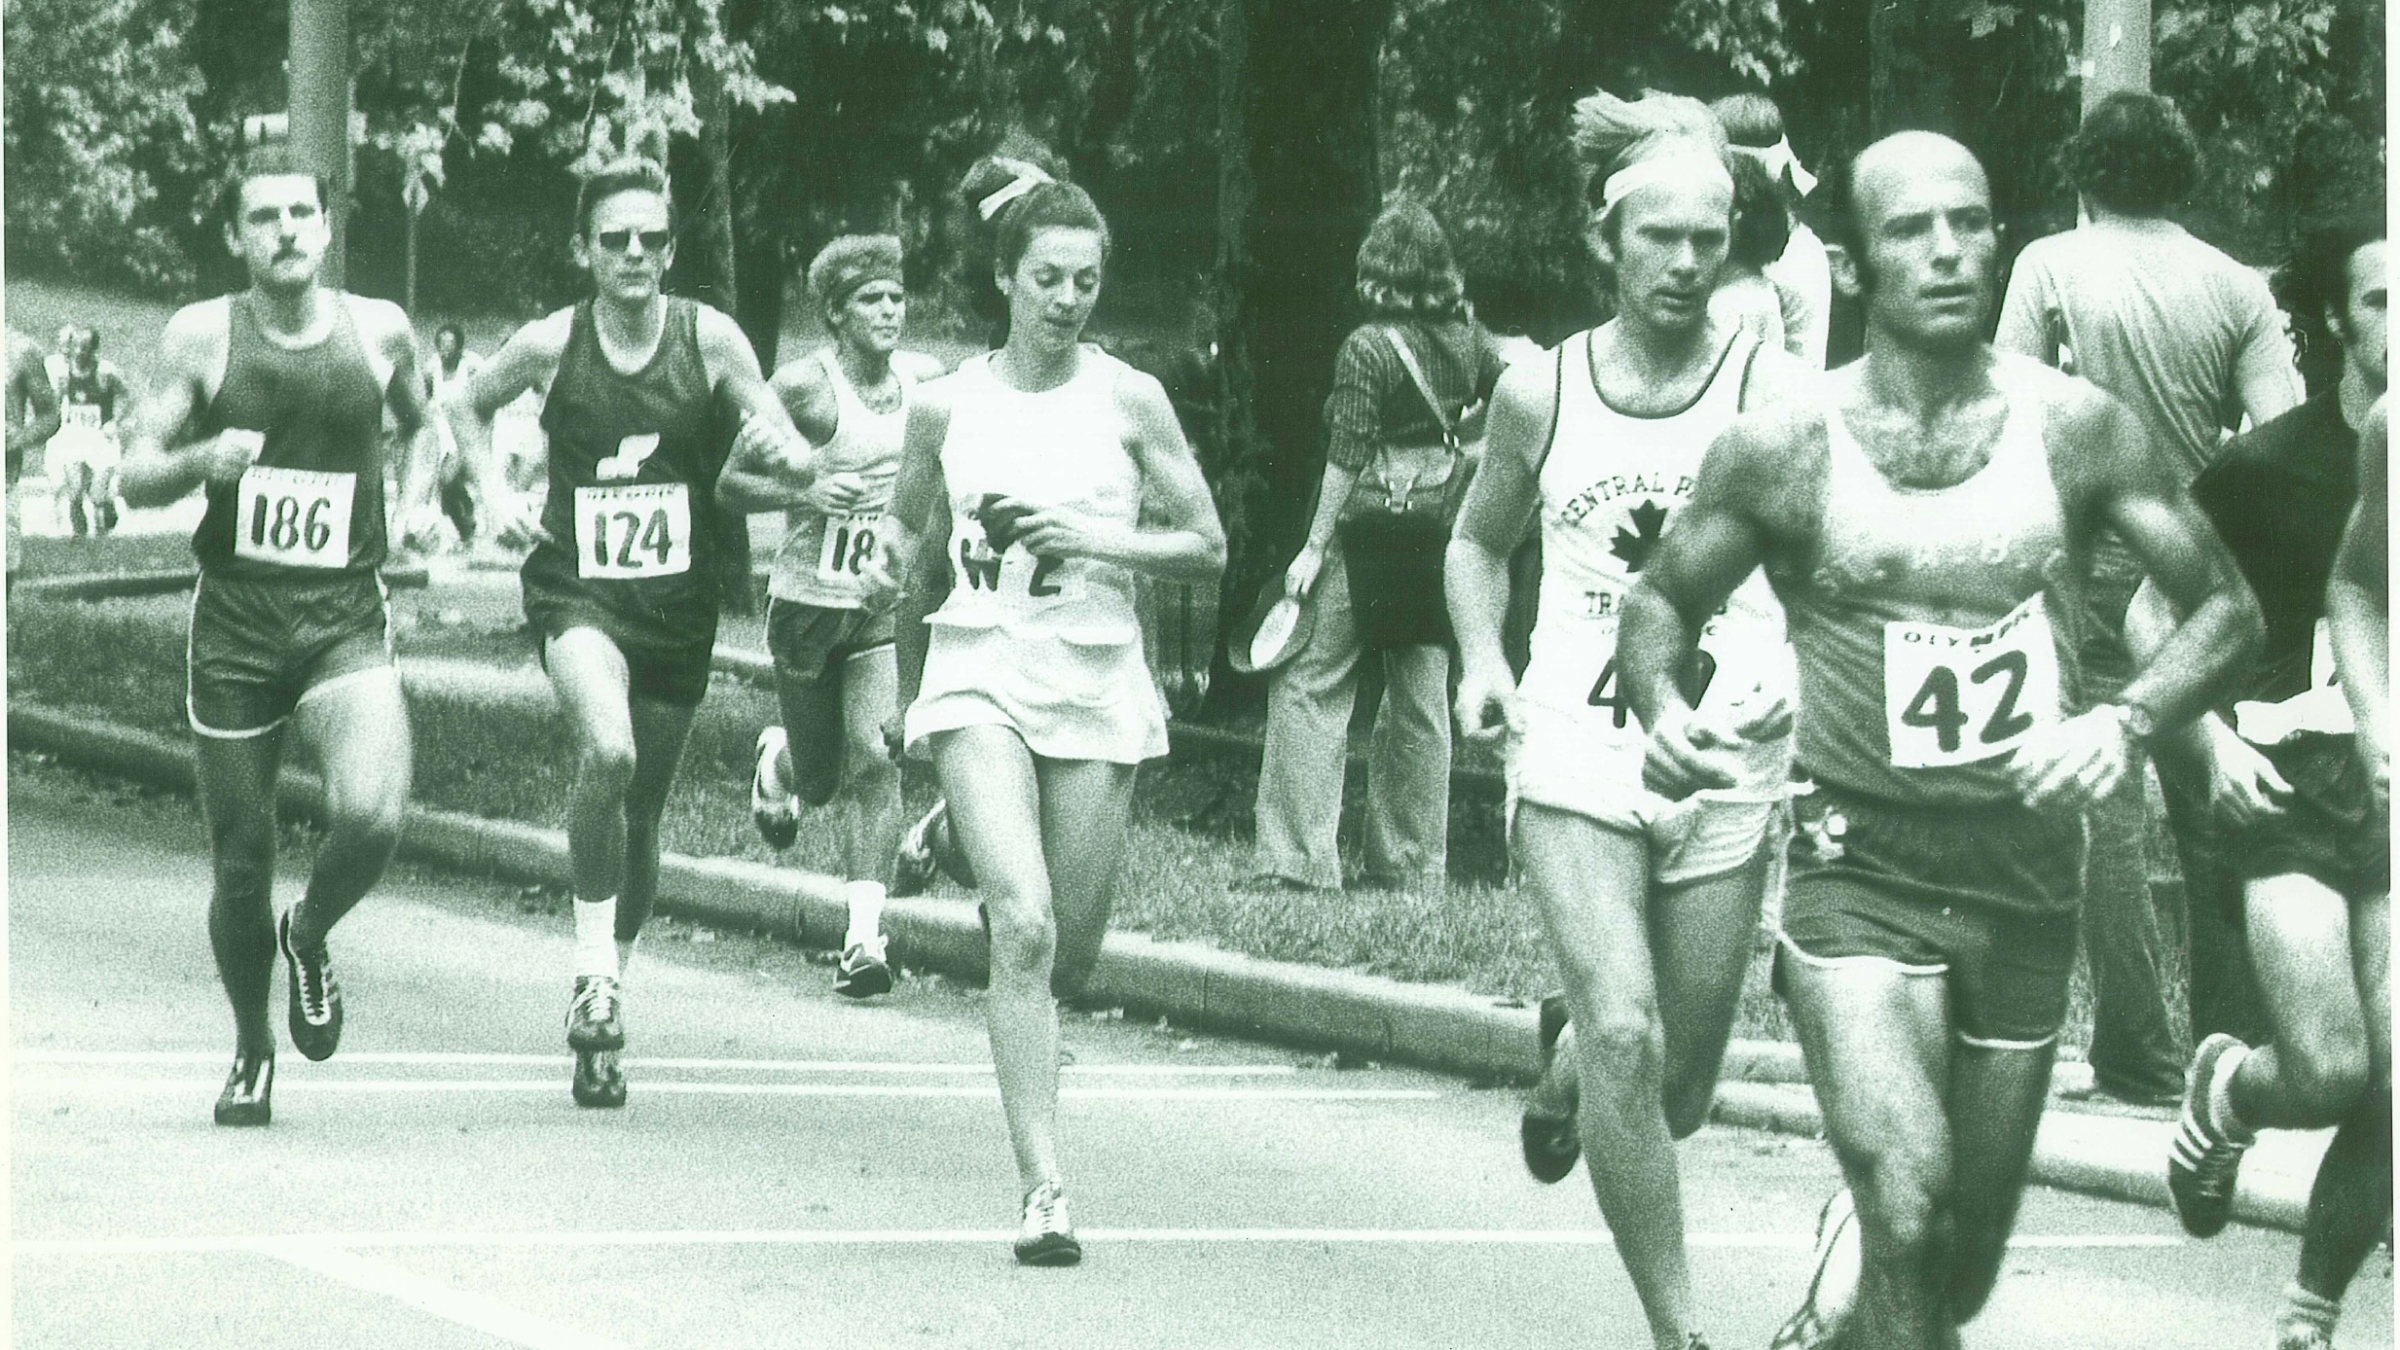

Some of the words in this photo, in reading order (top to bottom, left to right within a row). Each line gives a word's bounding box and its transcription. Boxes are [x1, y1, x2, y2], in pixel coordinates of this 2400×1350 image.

[250, 494, 331, 551] 186
[1561, 472, 1664, 527] CENTRAL
[594, 508, 673, 567] 124
[1901, 650, 2034, 753] 42
